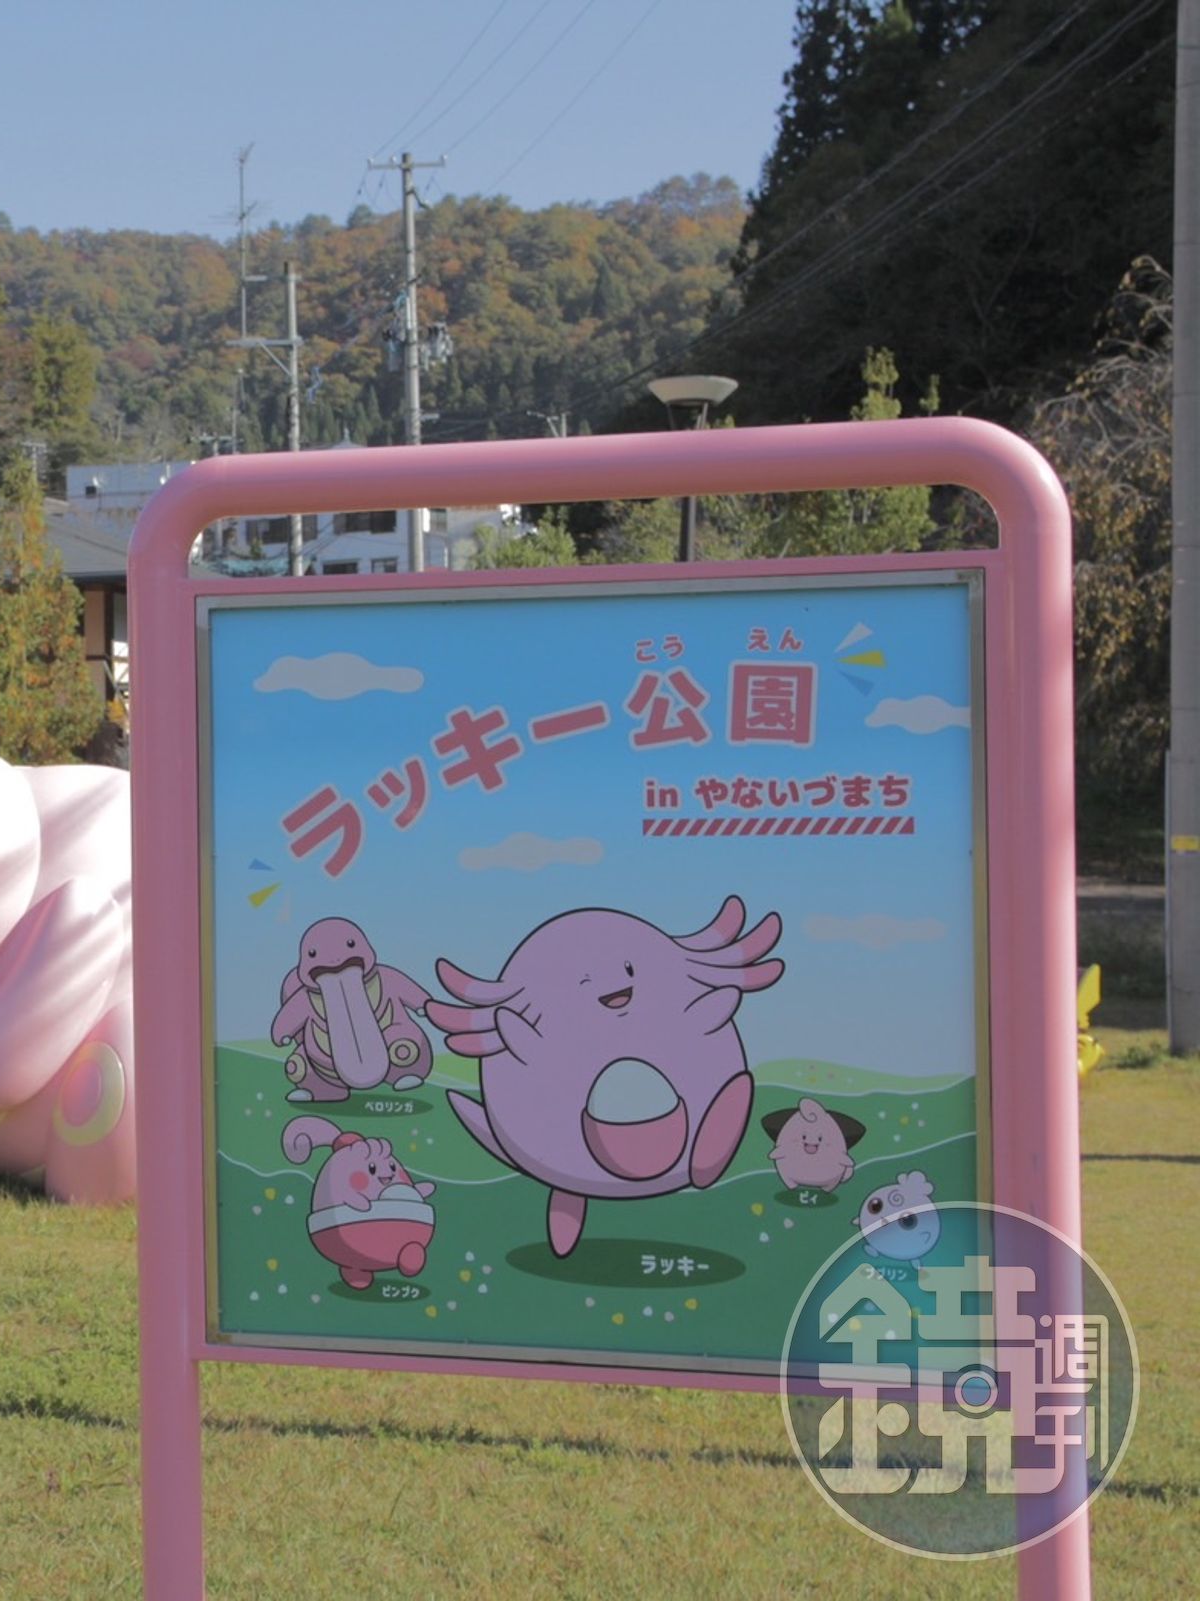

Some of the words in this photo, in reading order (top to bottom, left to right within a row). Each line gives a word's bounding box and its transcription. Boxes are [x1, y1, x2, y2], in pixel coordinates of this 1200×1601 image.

[636, 636, 684, 662] こう
[748, 628, 802, 651] えん
[282, 664, 814, 877] ラッキー公園
[646, 781, 679, 808] in
[695, 775, 909, 809] やないづまち
[641, 1255, 710, 1277] ラッキー
